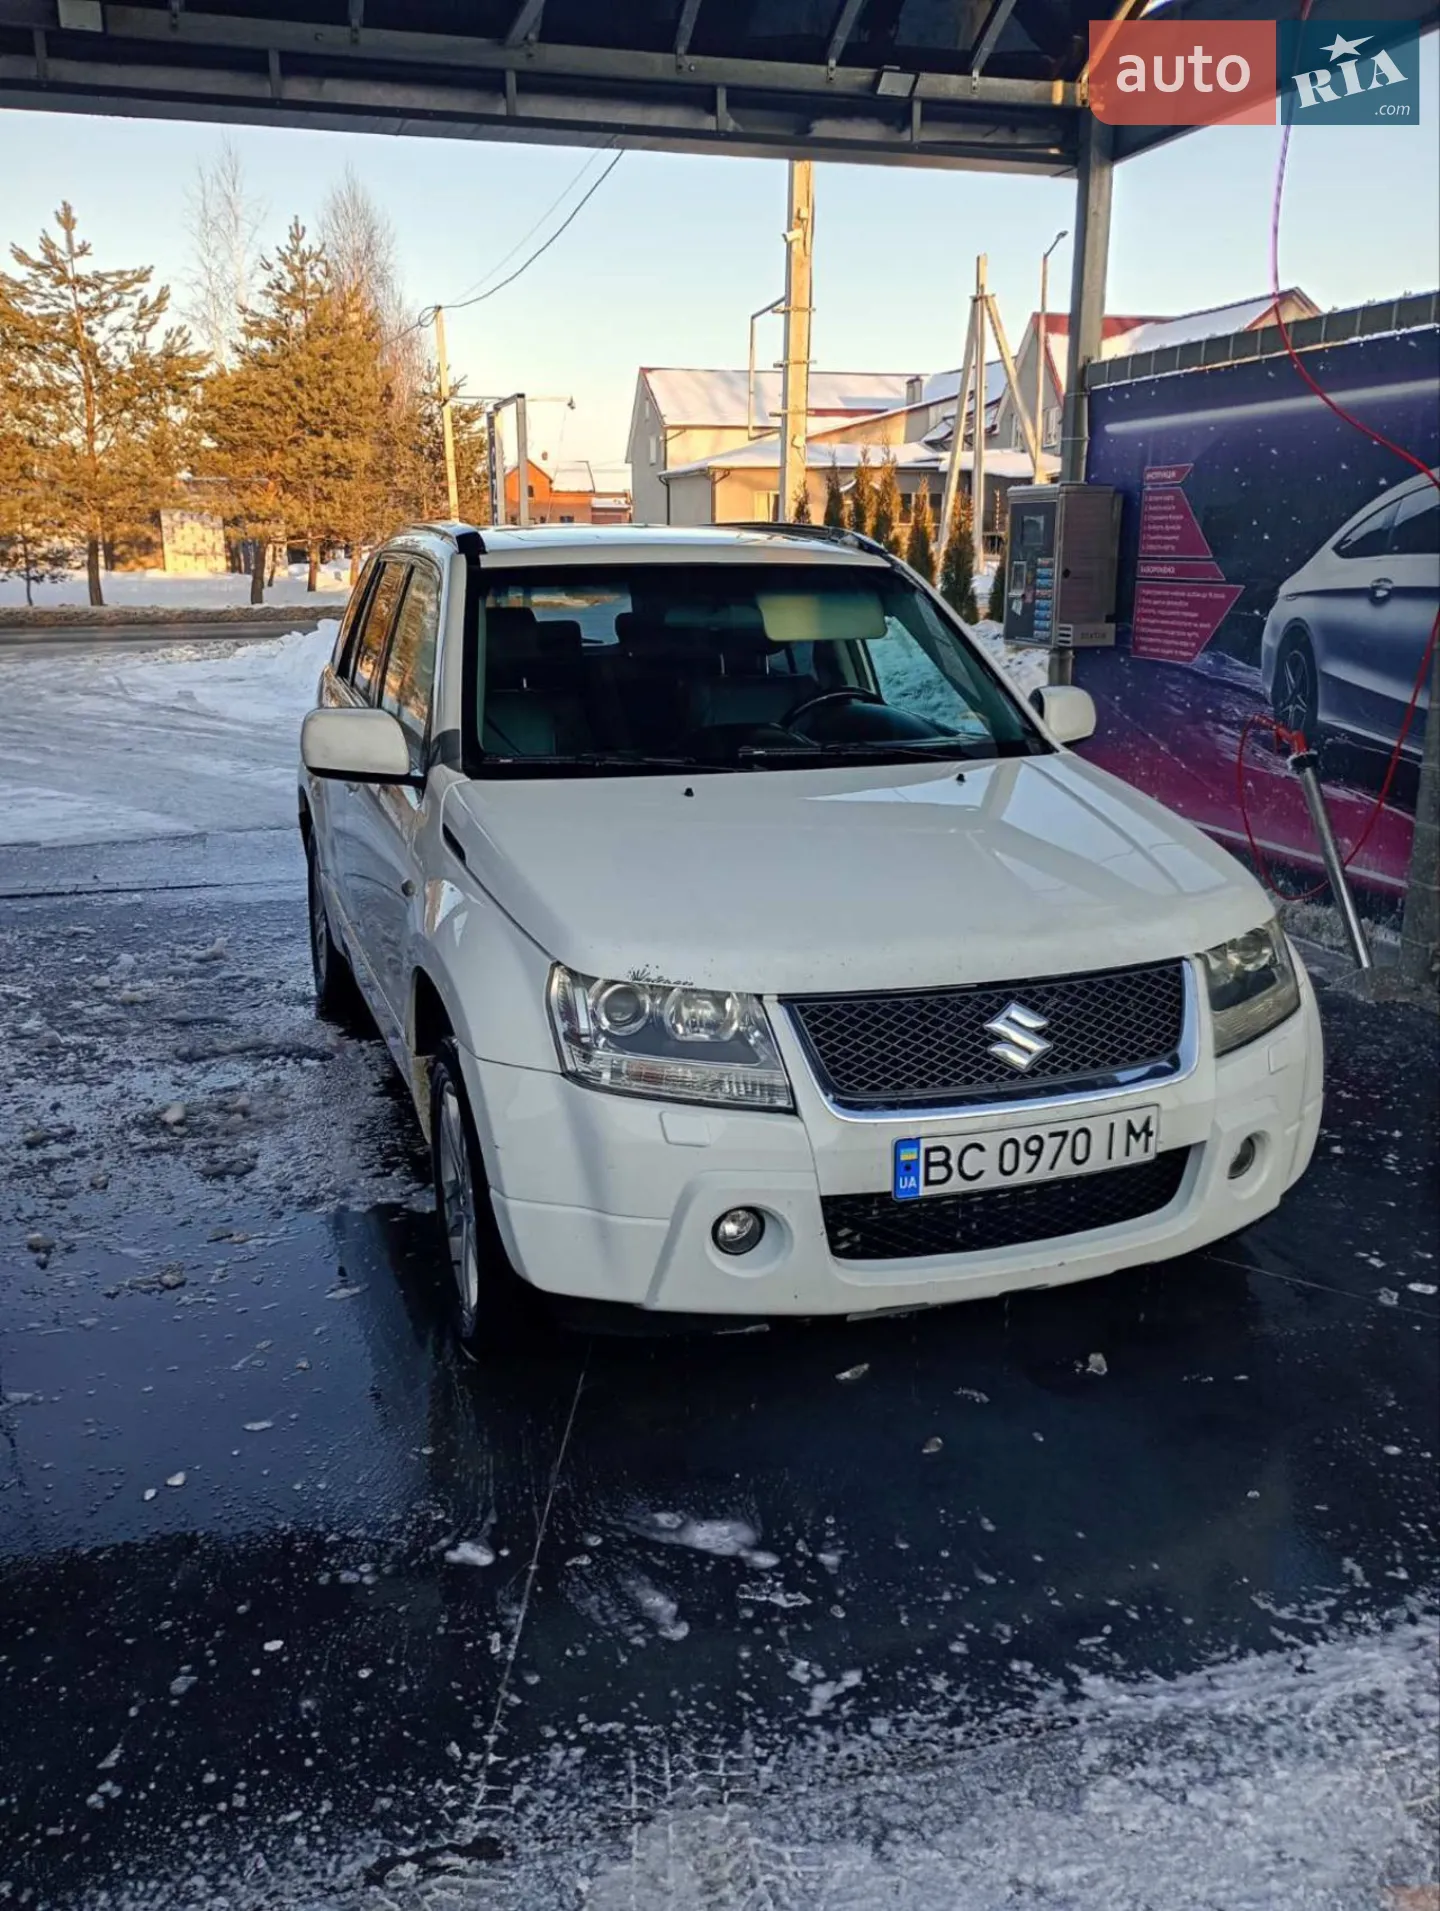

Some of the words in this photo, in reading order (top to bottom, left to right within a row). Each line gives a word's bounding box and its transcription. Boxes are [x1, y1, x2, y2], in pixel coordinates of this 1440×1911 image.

[924, 1143, 985, 1187] BC
[999, 1127, 1091, 1177] 0970
[899, 1176, 917, 1189] UA
